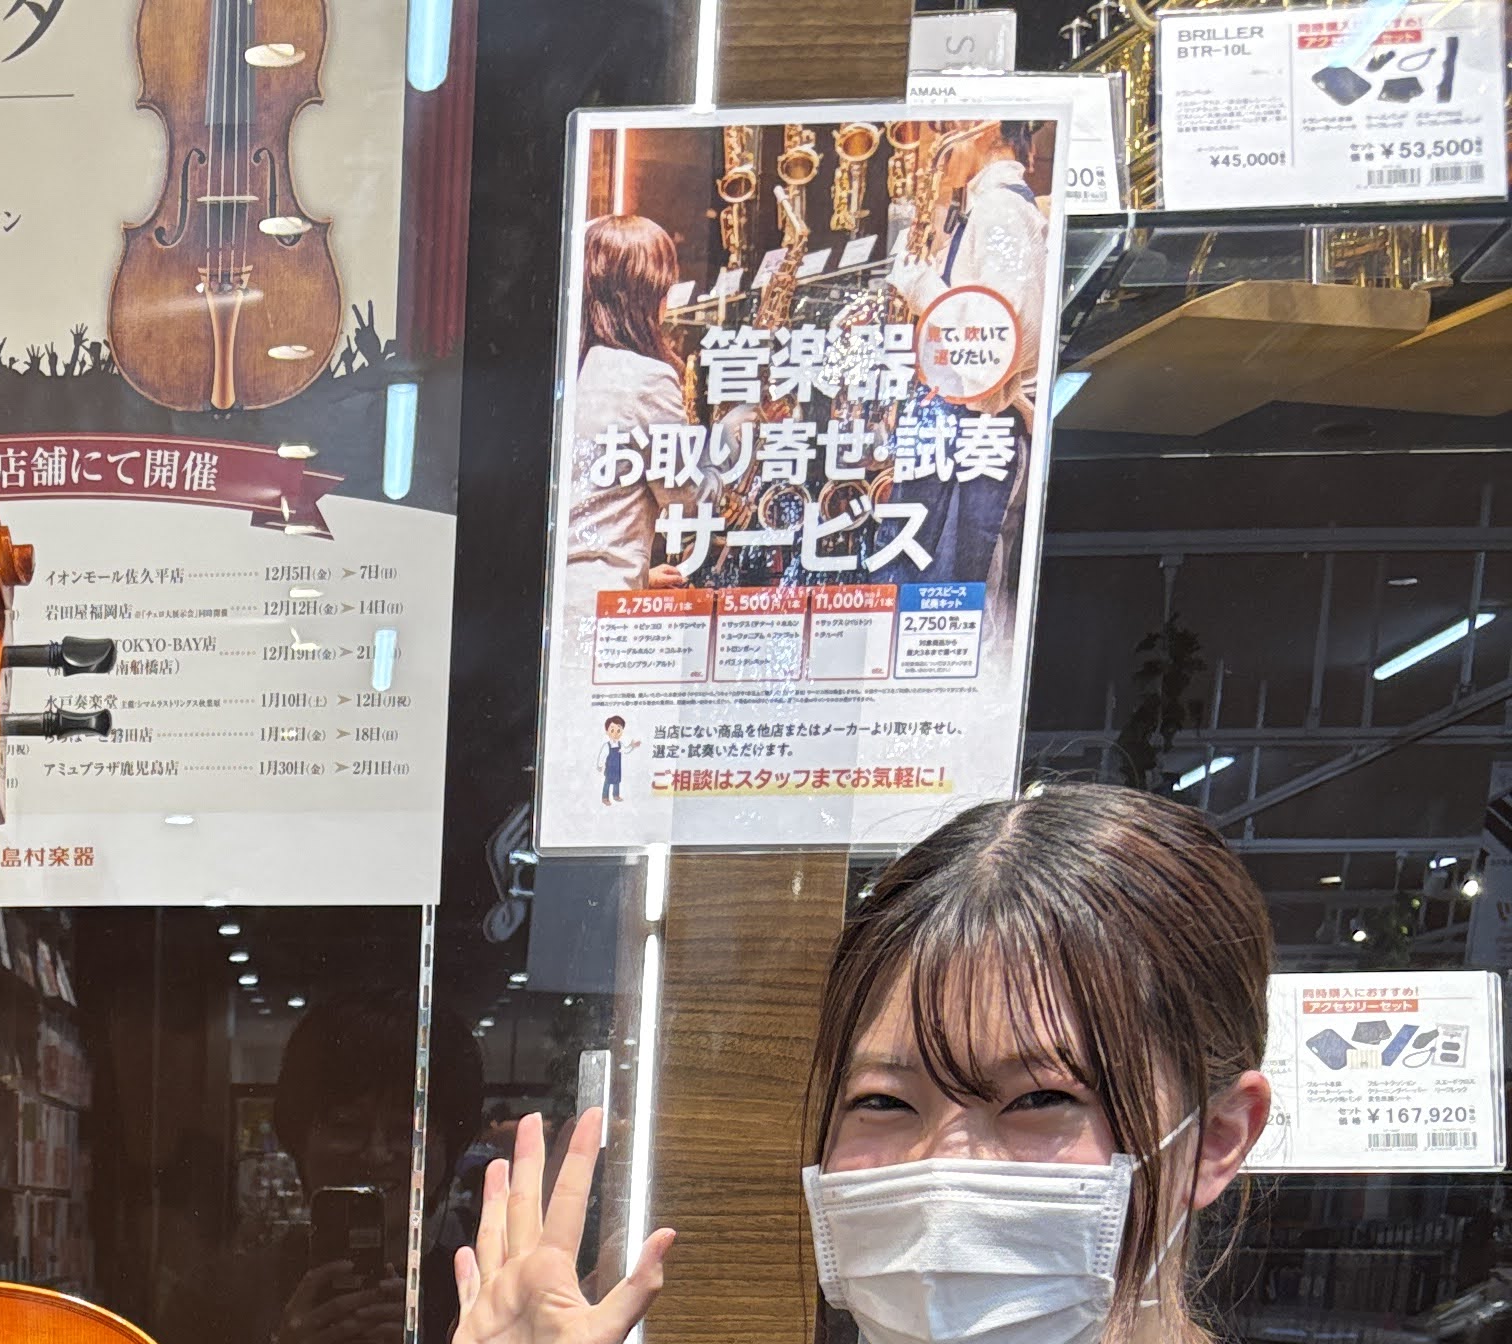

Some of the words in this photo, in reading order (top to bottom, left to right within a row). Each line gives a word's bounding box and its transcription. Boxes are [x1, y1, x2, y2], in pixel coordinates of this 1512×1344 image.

[1177, 26, 1264, 43] BRILLER
[1177, 44, 1252, 58] BTR-10L
[1380, 139, 1473, 160] ¥53,500
[1209, 153, 1279, 168] ¥45,000
[699, 324, 916, 405] 管楽器
[590, 415, 1015, 489] お取り寄せ・試奏
[654, 495, 933, 579] サービス
[45, 568, 184, 585] イオンモール佐久平店
[265, 566, 331, 581] 12月5日(金)
[360, 565, 397, 580] 7日(日)
[918, 587, 967, 597] マウスピース
[45, 603, 133, 621] 岩田屋福岡店
[264, 600, 338, 616] 12月12日(金)
[359, 600, 404, 614] 14日(日)
[261, 693, 328, 708] 1月10日(土)
[355, 727, 399, 742] 18日(日)
[653, 721, 963, 740] 当店にない商品を他店またはメーカーより取り寄せし、
[651, 742, 794, 760] 選定・試奏いただけます。
[44, 761, 179, 777] アミュプラザ鹿児島店
[259, 760, 325, 775] 1月30日(金)
[352, 760, 410, 775] 2月1日(日)
[651, 766, 946, 792] ご相談はスタッフまでお気軽に！
[0, 846, 95, 867] 島村楽器
[1308, 1001, 1413, 1013] アクセサリーセット
[1368, 1106, 1467, 1124] ¥167,920
